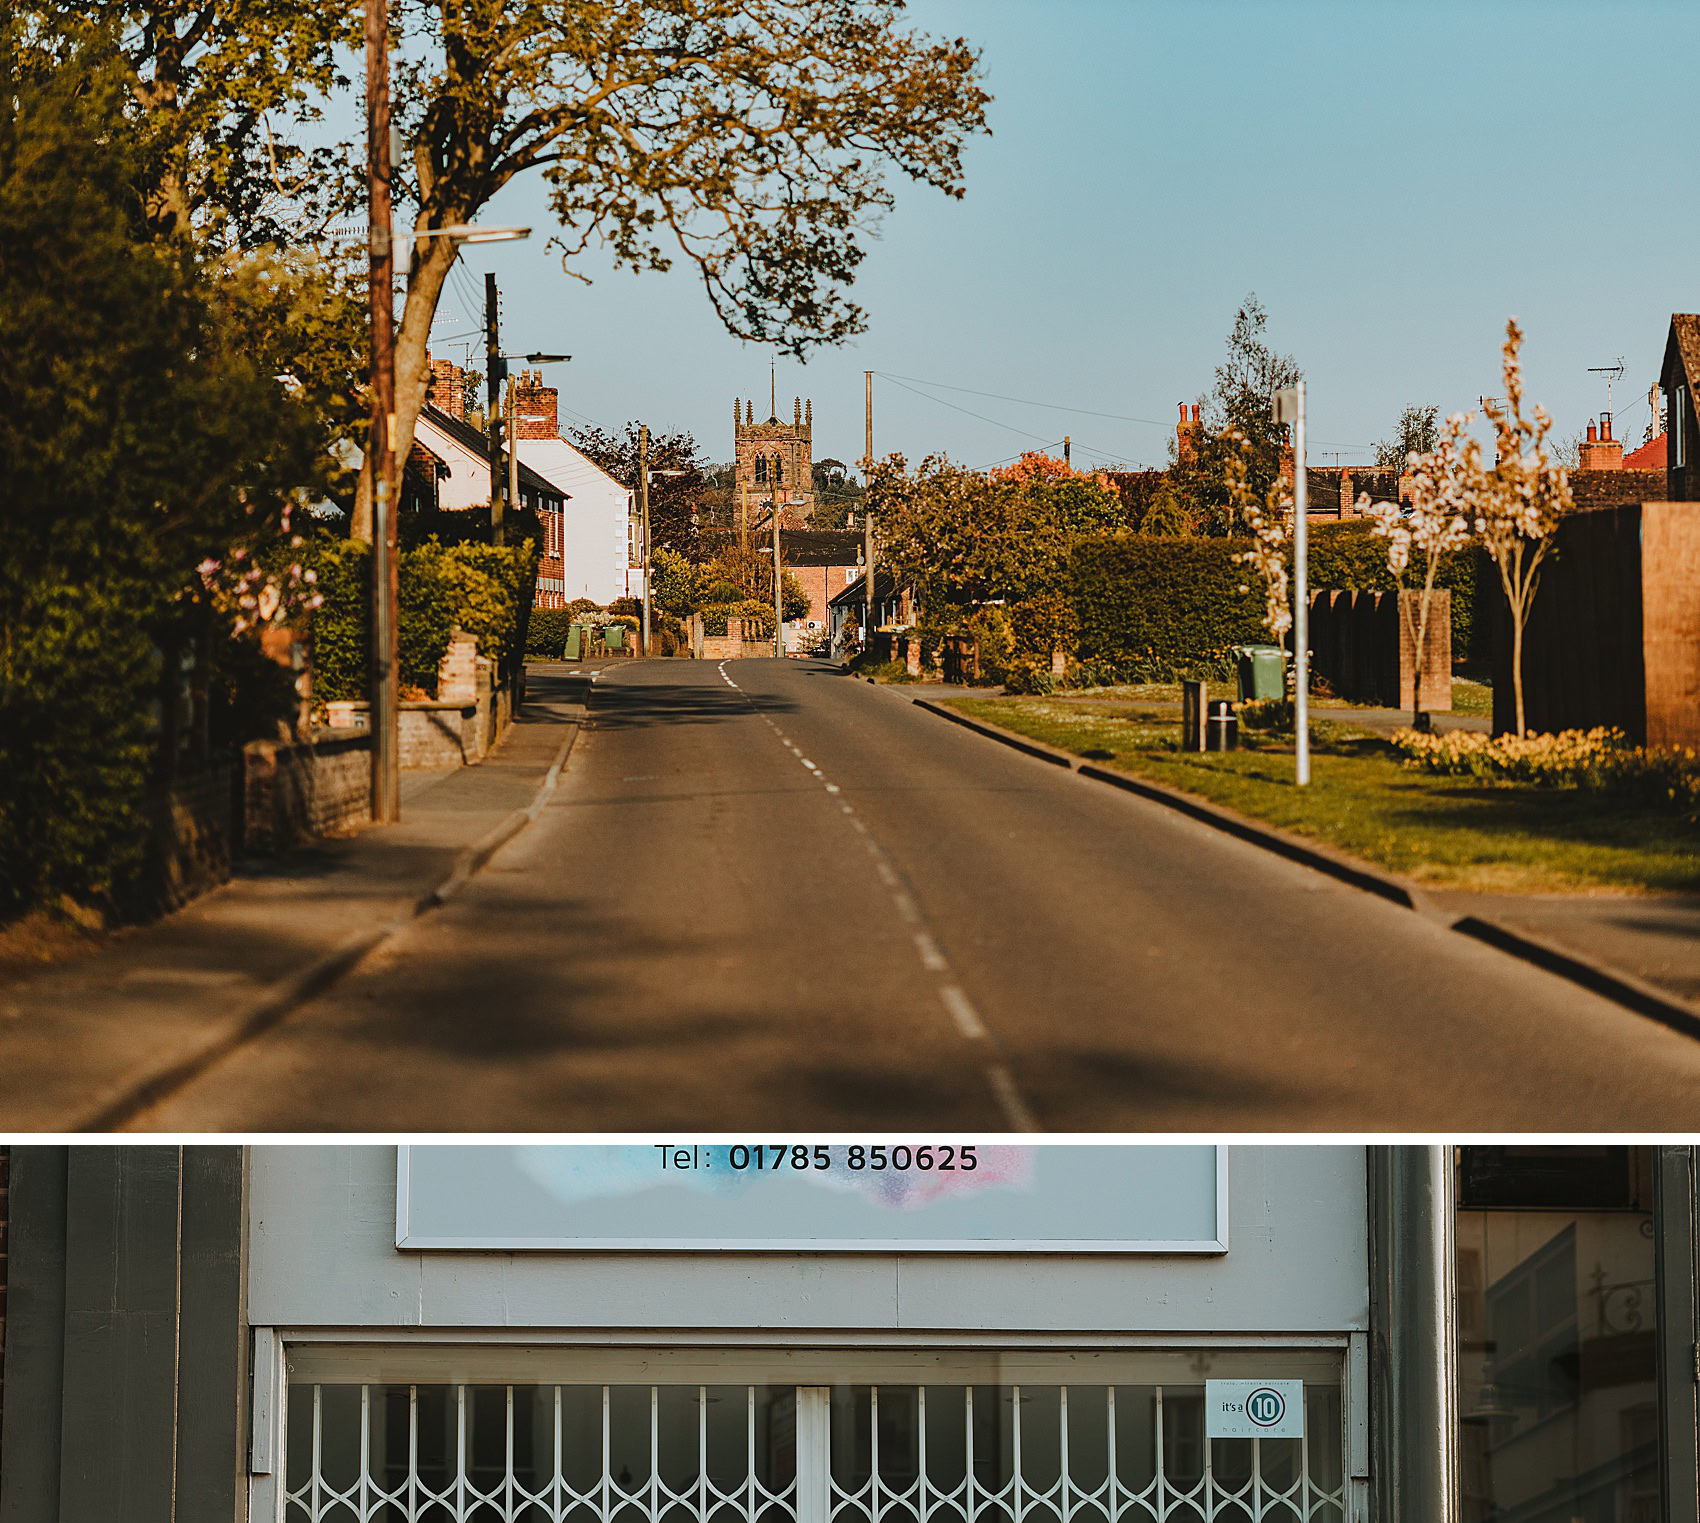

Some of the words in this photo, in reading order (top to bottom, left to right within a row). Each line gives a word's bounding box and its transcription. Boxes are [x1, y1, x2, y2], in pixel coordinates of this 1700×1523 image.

[654, 1145, 710, 1170] Tel:
[729, 1145, 831, 1170] 01785
[847, 1145, 978, 1170] 850625
[1222, 1402, 1236, 1412] it's
[1256, 1398, 1276, 1418] 10
